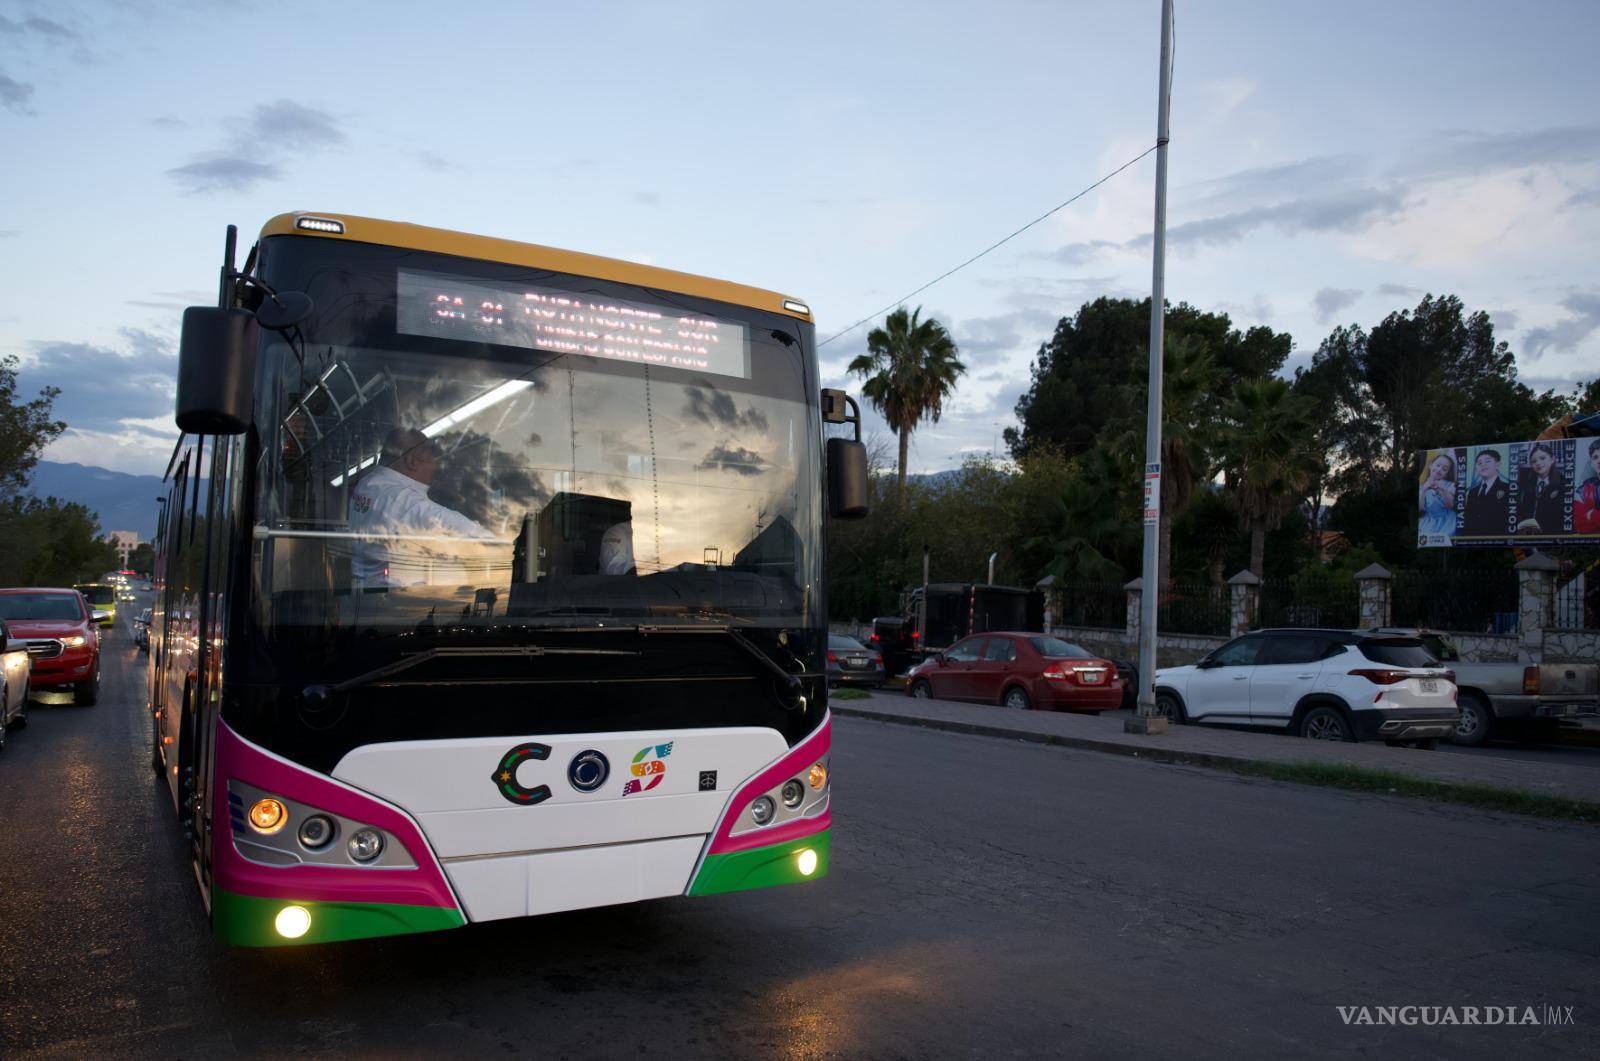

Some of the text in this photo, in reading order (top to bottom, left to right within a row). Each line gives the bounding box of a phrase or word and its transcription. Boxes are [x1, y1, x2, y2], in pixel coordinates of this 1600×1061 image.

[1456, 455, 1467, 529] HAPPINESS
[1508, 446, 1520, 533] CONFIDENCE
[1563, 443, 1576, 531] EXCELLENCE
